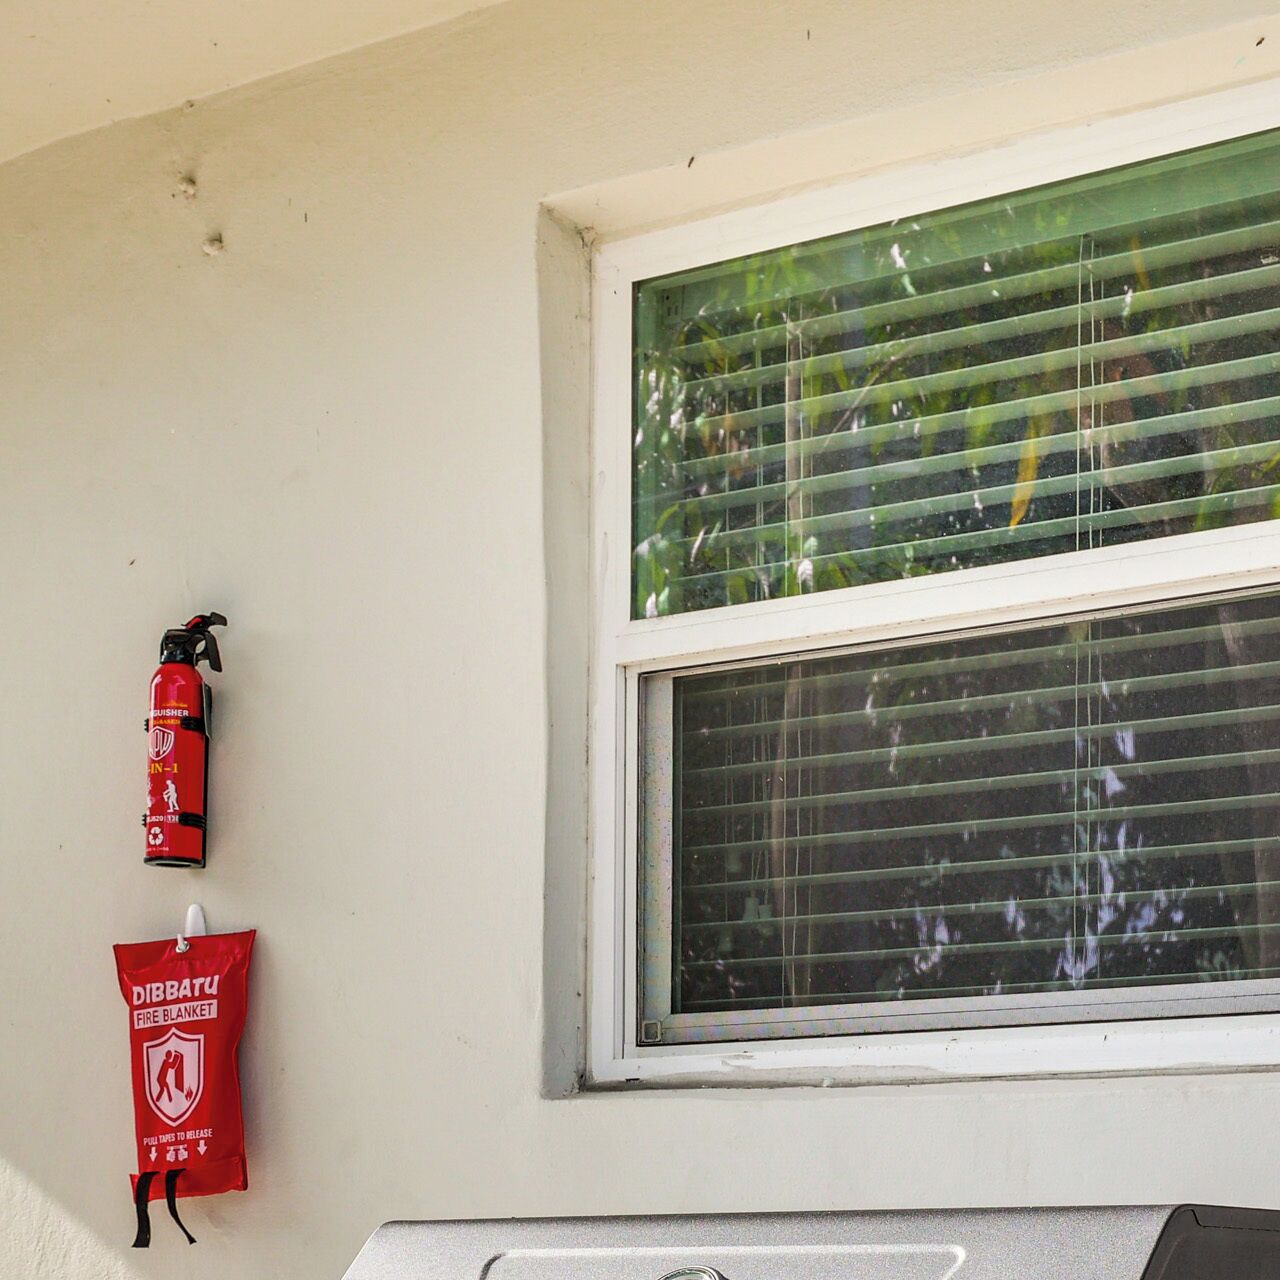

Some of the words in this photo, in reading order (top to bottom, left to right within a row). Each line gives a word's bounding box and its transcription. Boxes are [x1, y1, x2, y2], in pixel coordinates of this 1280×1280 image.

[132, 974, 220, 1006] DIBBATU
[136, 1010, 160, 1027] FIRE
[163, 1002, 214, 1022] BLANKET
[143, 1137, 158, 1146] PULL
[159, 1133, 176, 1144] TAPES
[177, 1131, 186, 1141] TO
[186, 1128, 214, 1140] RELEASE
